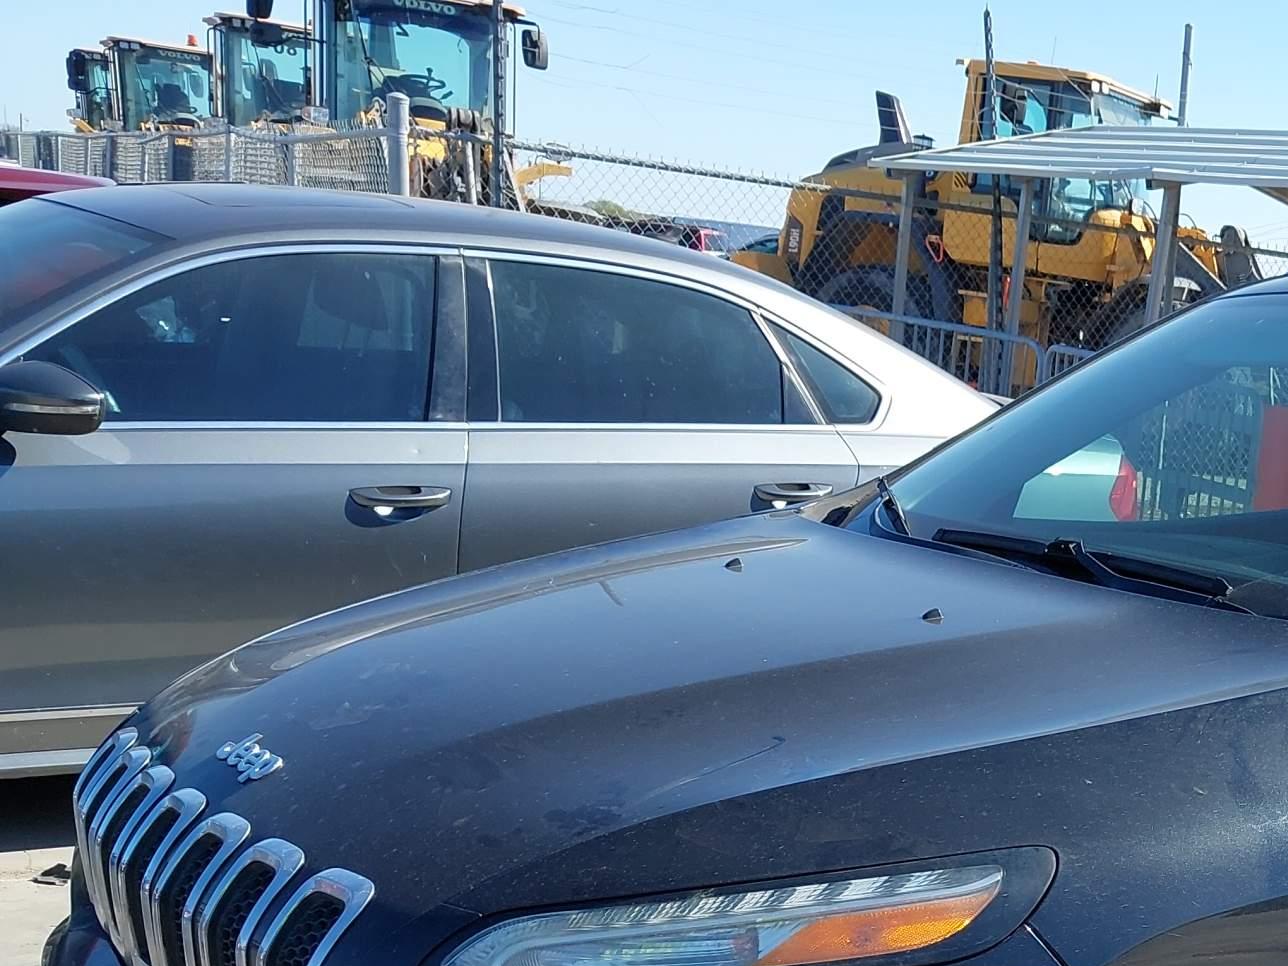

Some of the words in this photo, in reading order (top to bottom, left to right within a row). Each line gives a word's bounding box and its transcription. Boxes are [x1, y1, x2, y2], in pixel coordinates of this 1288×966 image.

[392, 0, 456, 15] VOLVO
[158, 50, 201, 61] VOLVO
[216, 733, 283, 783] Jeep
